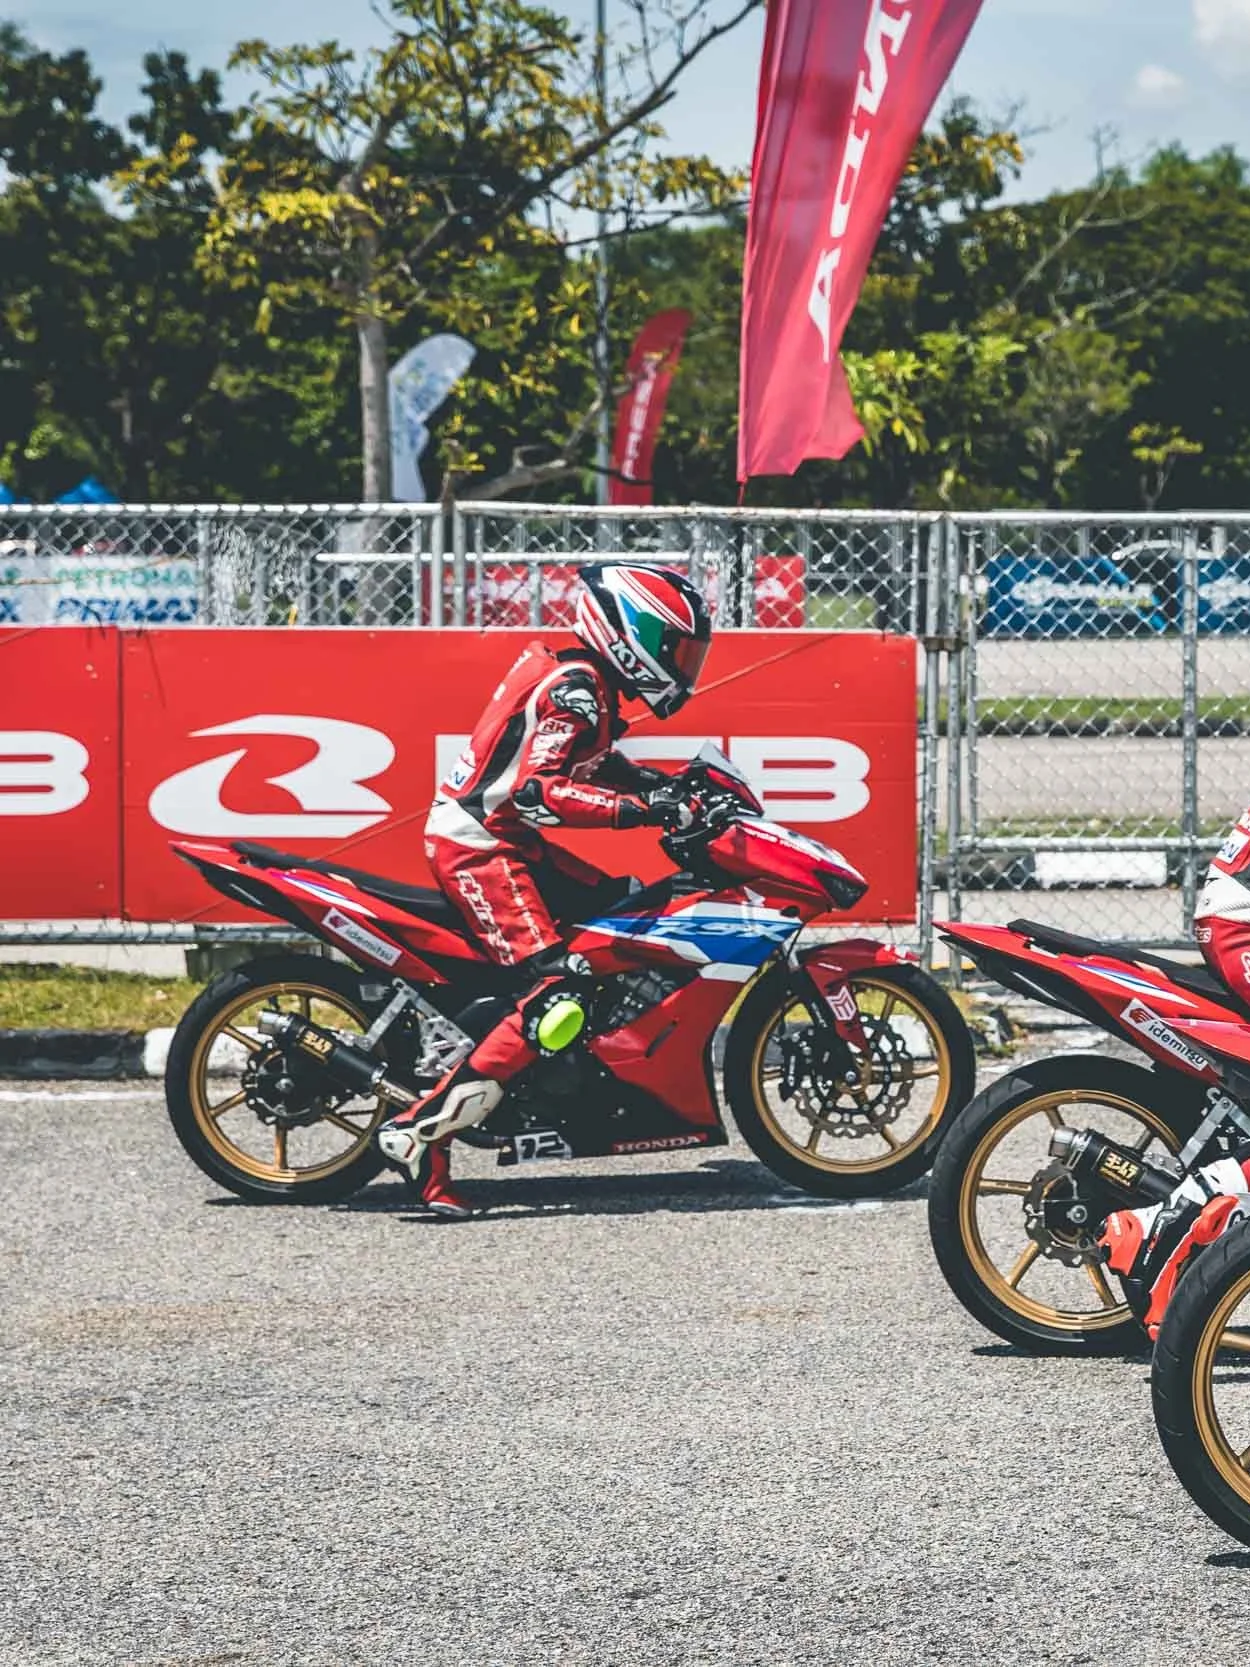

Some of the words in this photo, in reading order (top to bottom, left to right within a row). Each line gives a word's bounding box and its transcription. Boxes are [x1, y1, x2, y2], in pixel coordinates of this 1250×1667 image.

[608, 638, 659, 683] KYT
[1149, 1021, 1206, 1066] idemitsu
[616, 1136, 702, 1152] HONDA
